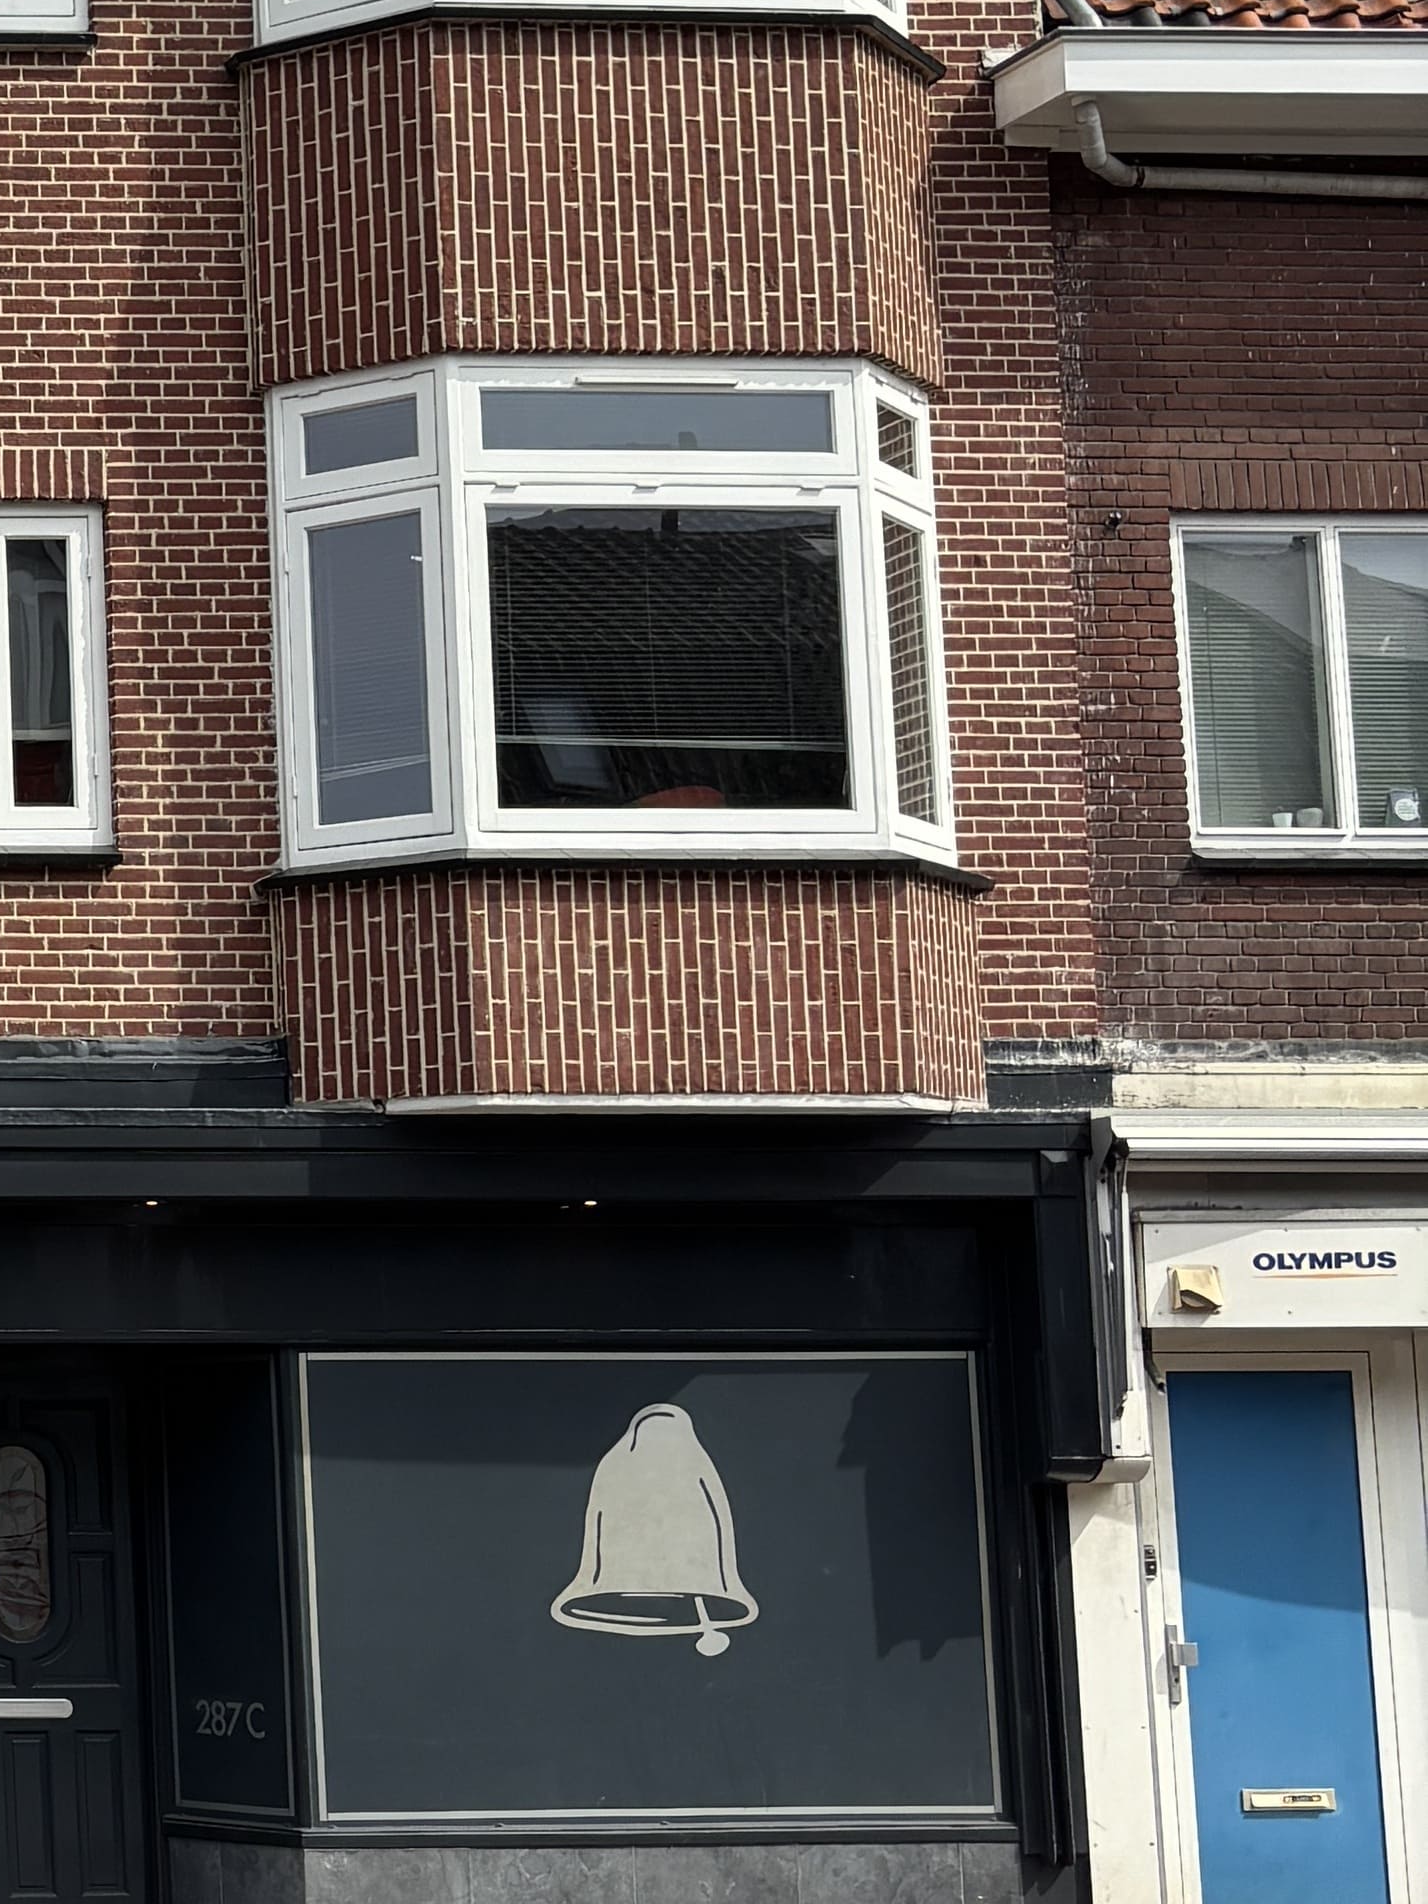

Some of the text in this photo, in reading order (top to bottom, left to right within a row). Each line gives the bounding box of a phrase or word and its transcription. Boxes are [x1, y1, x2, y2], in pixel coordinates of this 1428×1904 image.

[1252, 1251, 1397, 1271] OLYMPUS
[196, 1699, 265, 1739] 287 C
